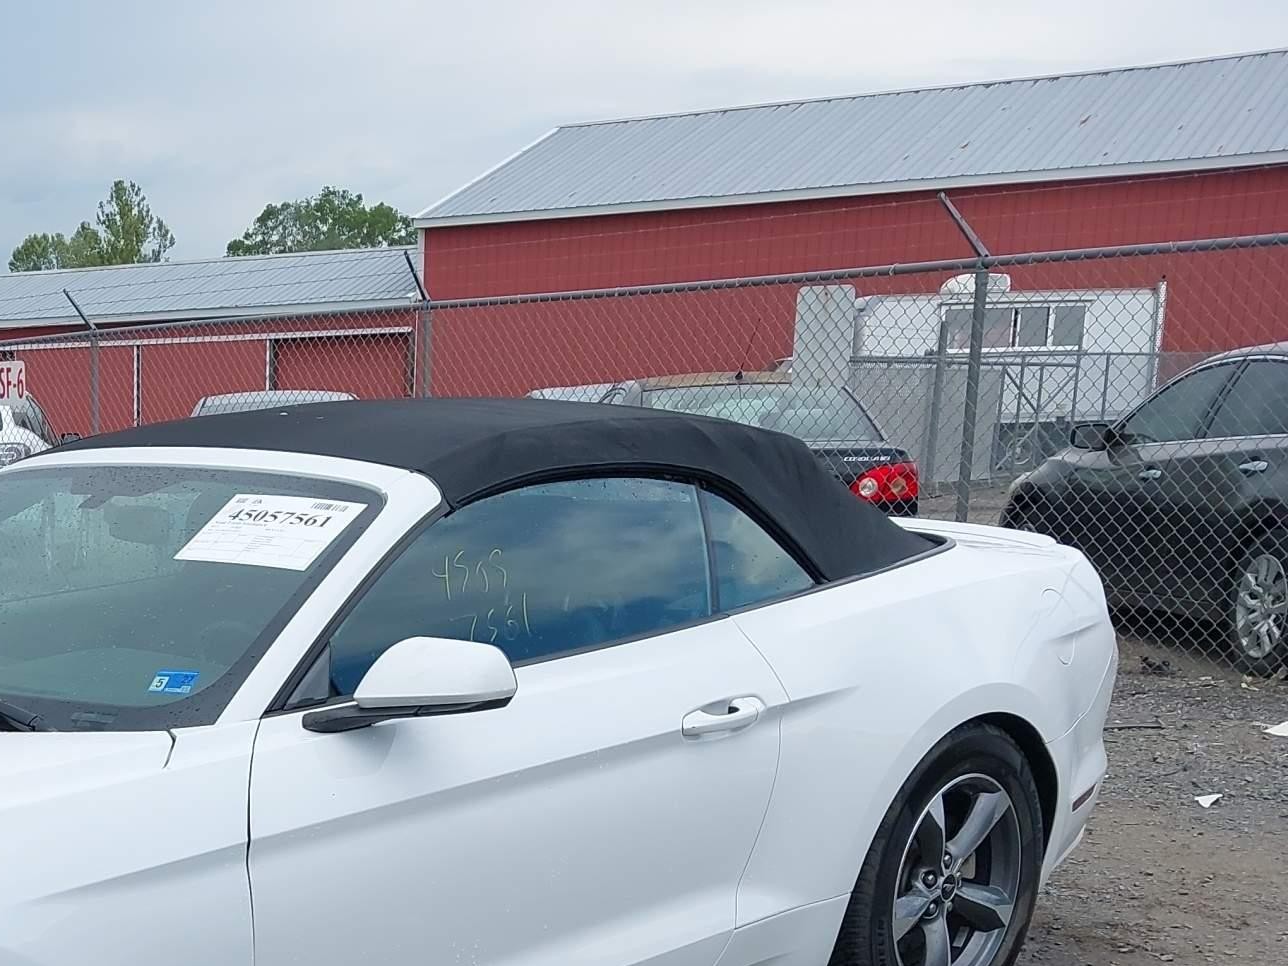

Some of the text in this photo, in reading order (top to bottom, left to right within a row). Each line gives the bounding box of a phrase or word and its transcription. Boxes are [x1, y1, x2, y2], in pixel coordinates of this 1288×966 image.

[0, 367, 24, 399] SF-6
[228, 508, 332, 528] 45057561
[155, 678, 164, 688] 5
